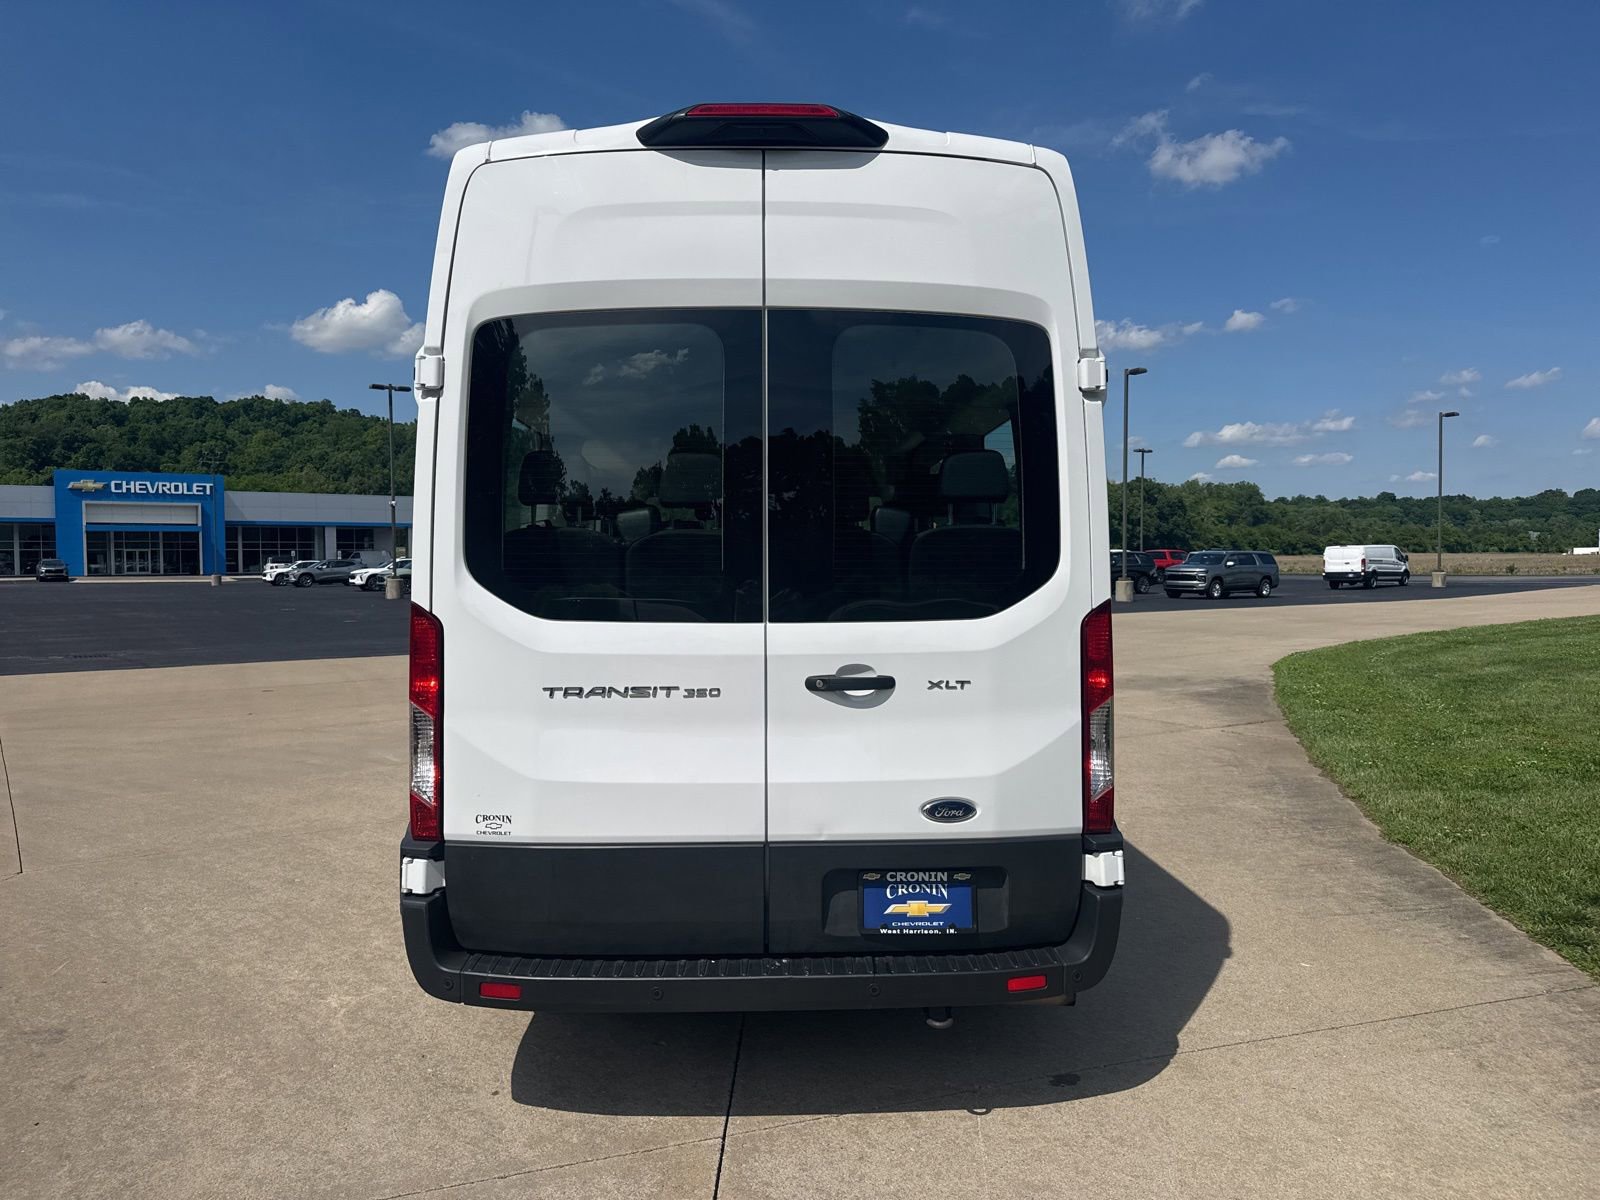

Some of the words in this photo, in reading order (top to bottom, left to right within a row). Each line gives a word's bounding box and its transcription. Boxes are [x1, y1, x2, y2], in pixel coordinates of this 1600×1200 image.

[110, 479, 214, 496] CHEVROLET
[927, 680, 971, 690] XLT
[542, 686, 680, 699] TRANSIT
[682, 687, 721, 699] 350
[935, 806, 965, 817] Ford
[475, 814, 512, 824] CRONIN
[886, 871, 948, 882] CRONIN
[886, 883, 948, 900] CRONIN
